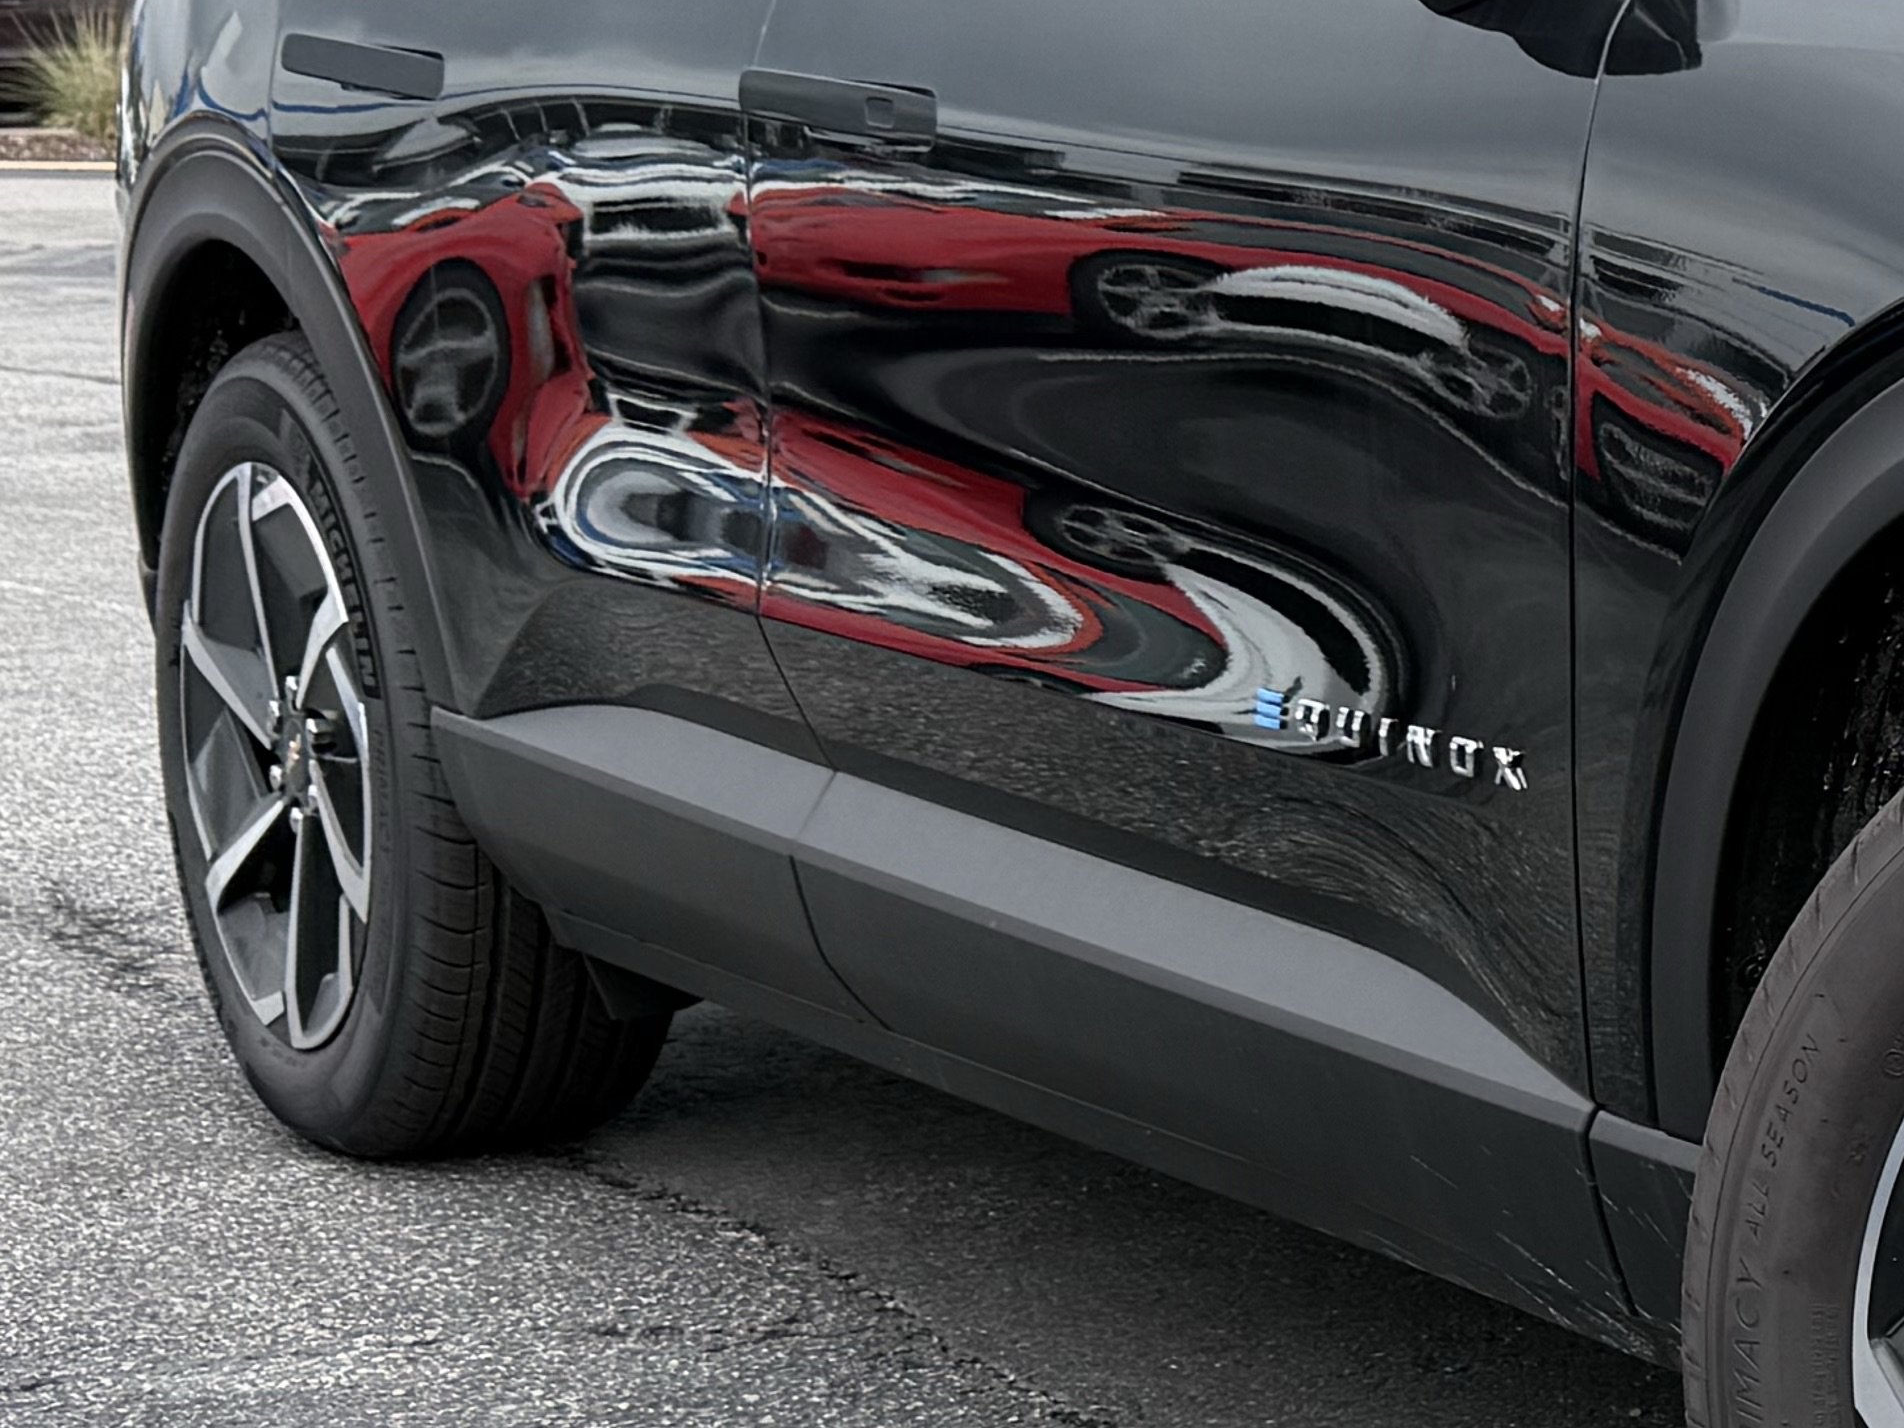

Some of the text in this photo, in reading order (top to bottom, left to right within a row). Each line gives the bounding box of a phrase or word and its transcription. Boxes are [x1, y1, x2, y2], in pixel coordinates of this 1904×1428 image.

[1253, 687, 1528, 792] EQUINOX
[1745, 1179, 1770, 1242] ALL
[1762, 1033, 1821, 1168] SEASON
